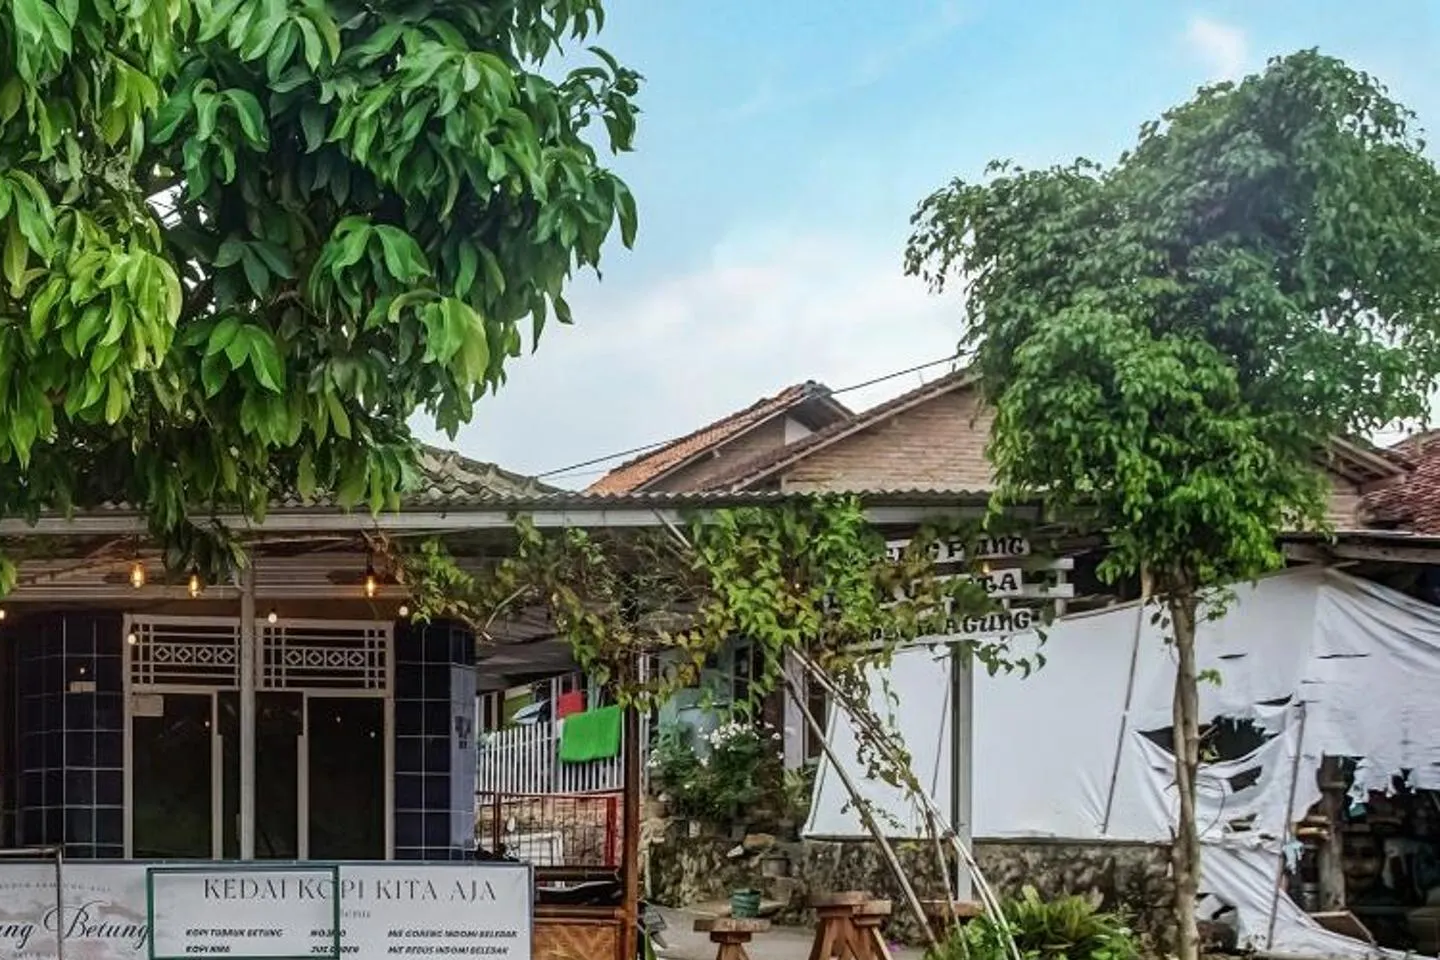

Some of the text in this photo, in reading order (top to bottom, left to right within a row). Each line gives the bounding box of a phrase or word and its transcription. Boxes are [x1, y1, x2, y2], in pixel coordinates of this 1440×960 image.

[204, 878, 497, 903] KEDAI KOPI KITA AJA
[43, 901, 150, 950] Betung
